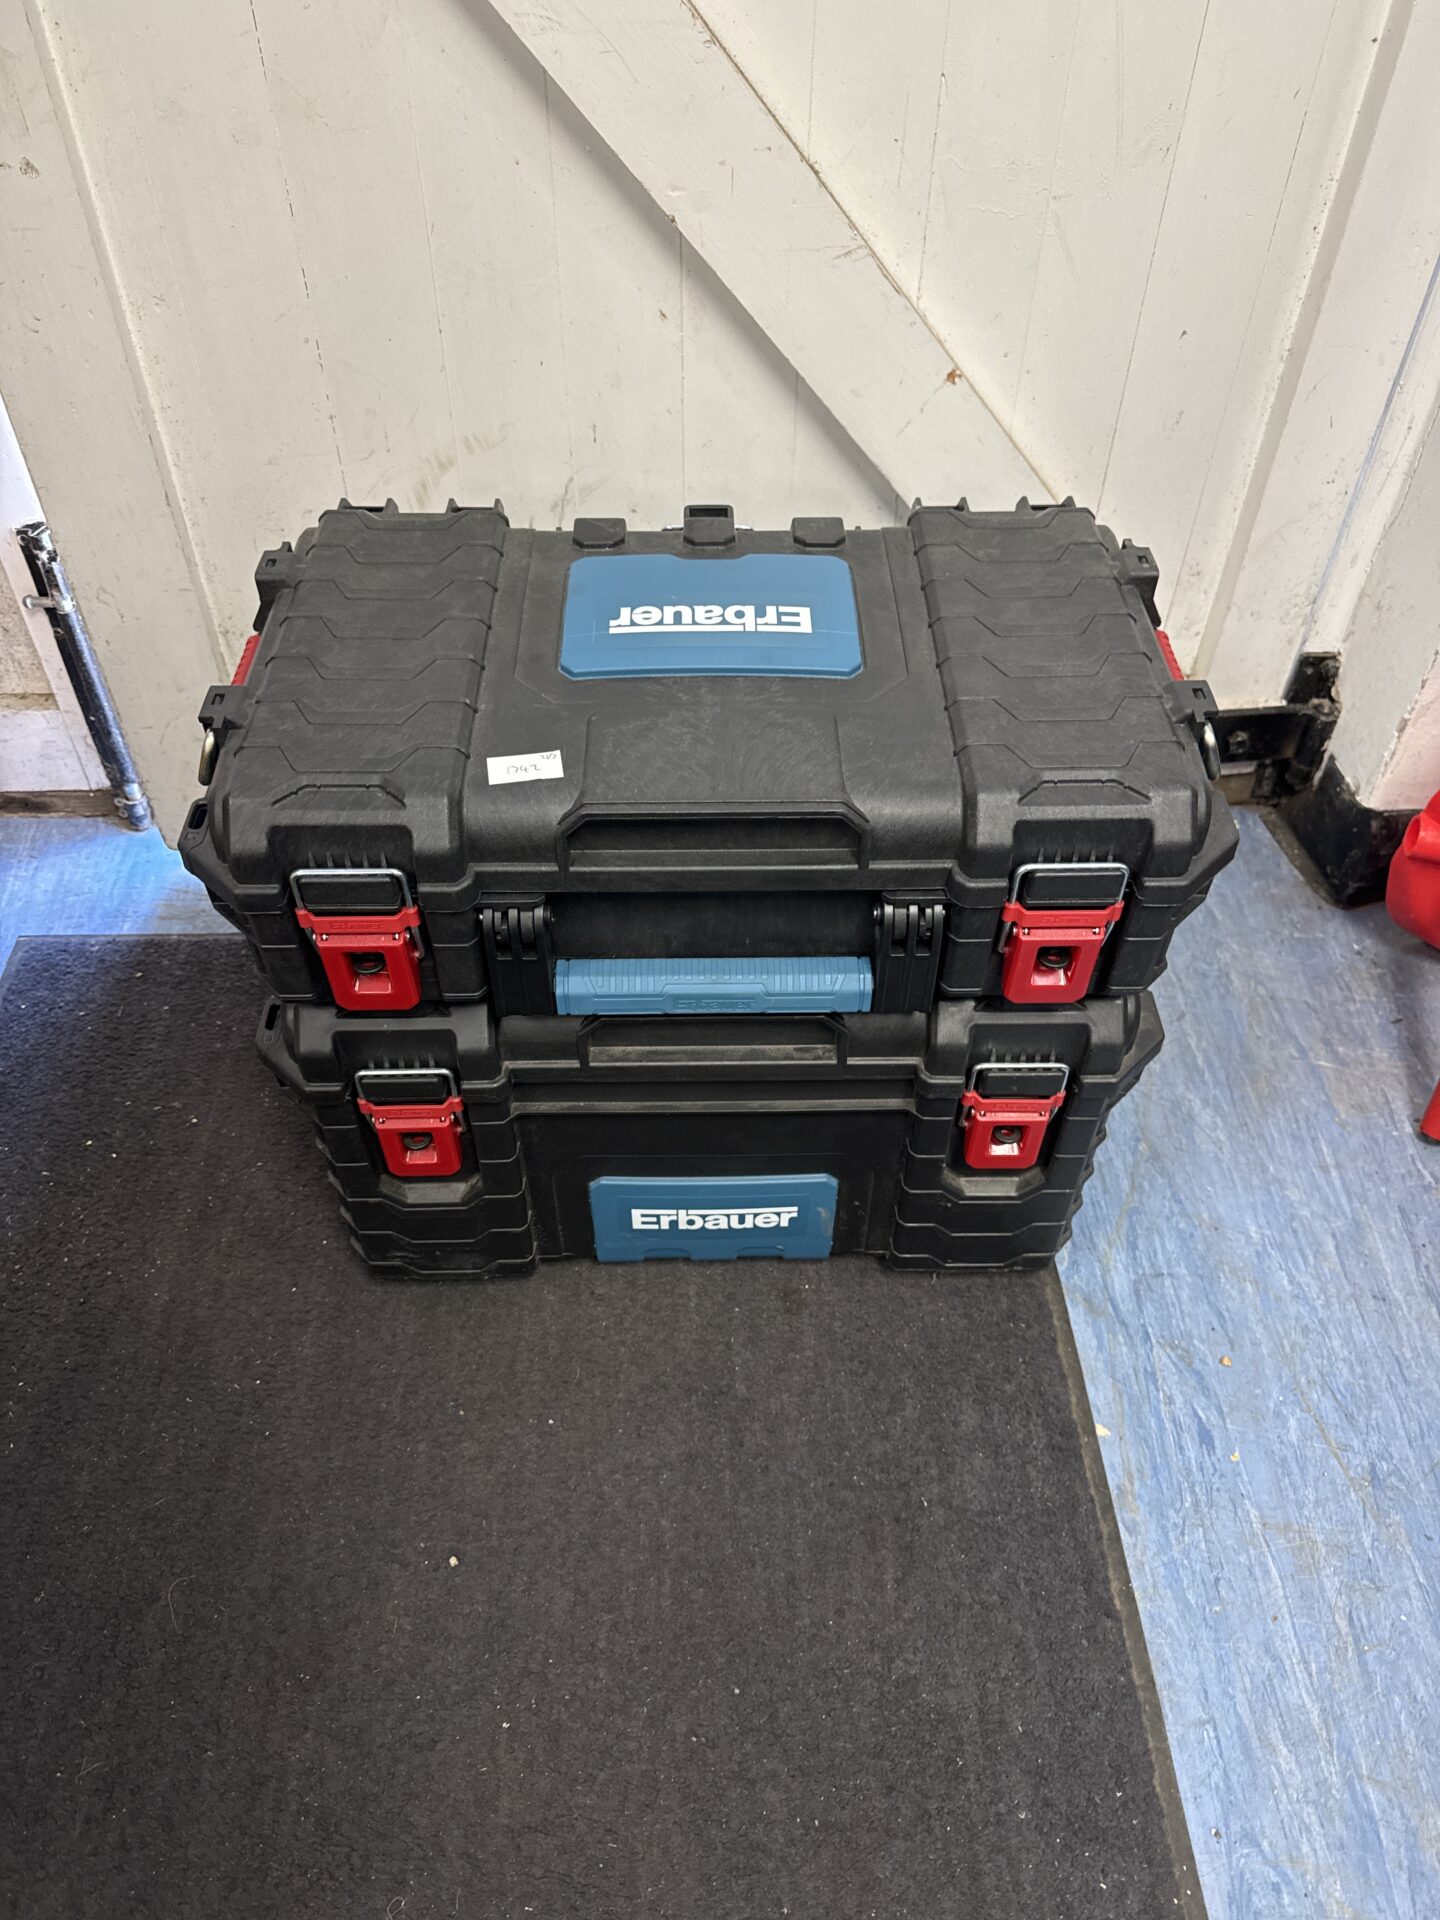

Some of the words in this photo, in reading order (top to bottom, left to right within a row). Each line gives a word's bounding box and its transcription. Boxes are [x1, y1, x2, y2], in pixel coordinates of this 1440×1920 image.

[609, 605, 812, 634] Erbauer
[506, 764, 541, 775] 1742
[674, 999, 756, 1011] Erbauer
[631, 1206, 799, 1230] Erbauer
